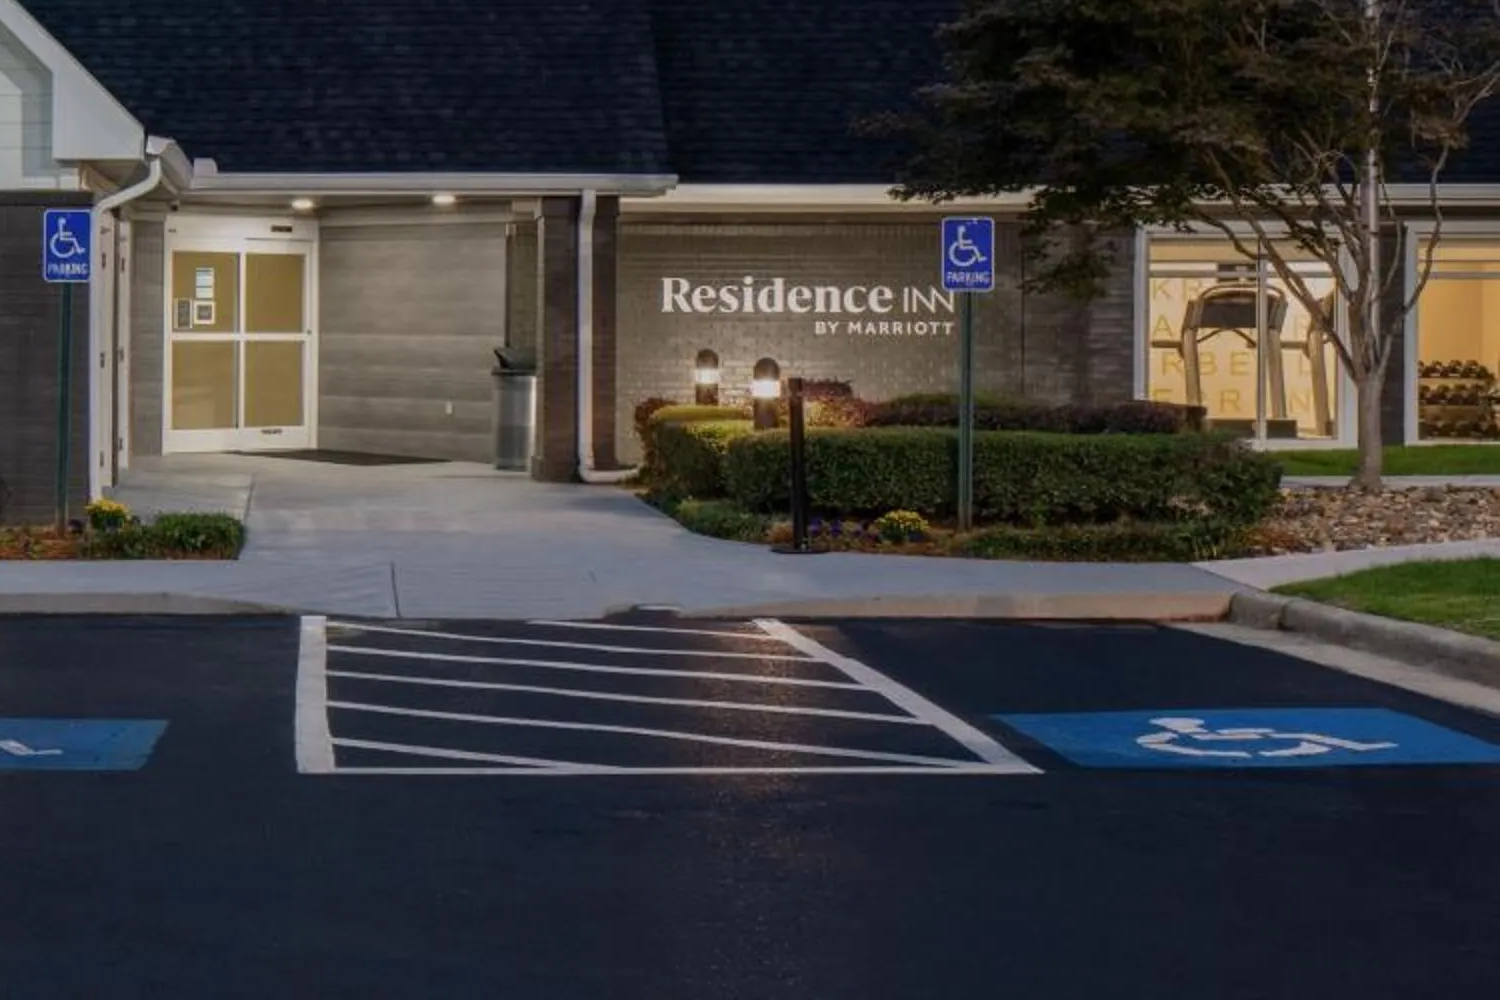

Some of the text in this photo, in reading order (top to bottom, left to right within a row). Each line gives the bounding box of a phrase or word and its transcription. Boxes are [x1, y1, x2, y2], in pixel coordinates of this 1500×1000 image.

[947, 271, 990, 285] PARKING
[661, 276, 955, 314] Residence INN
[814, 321, 955, 336] BY MARRIOTT
